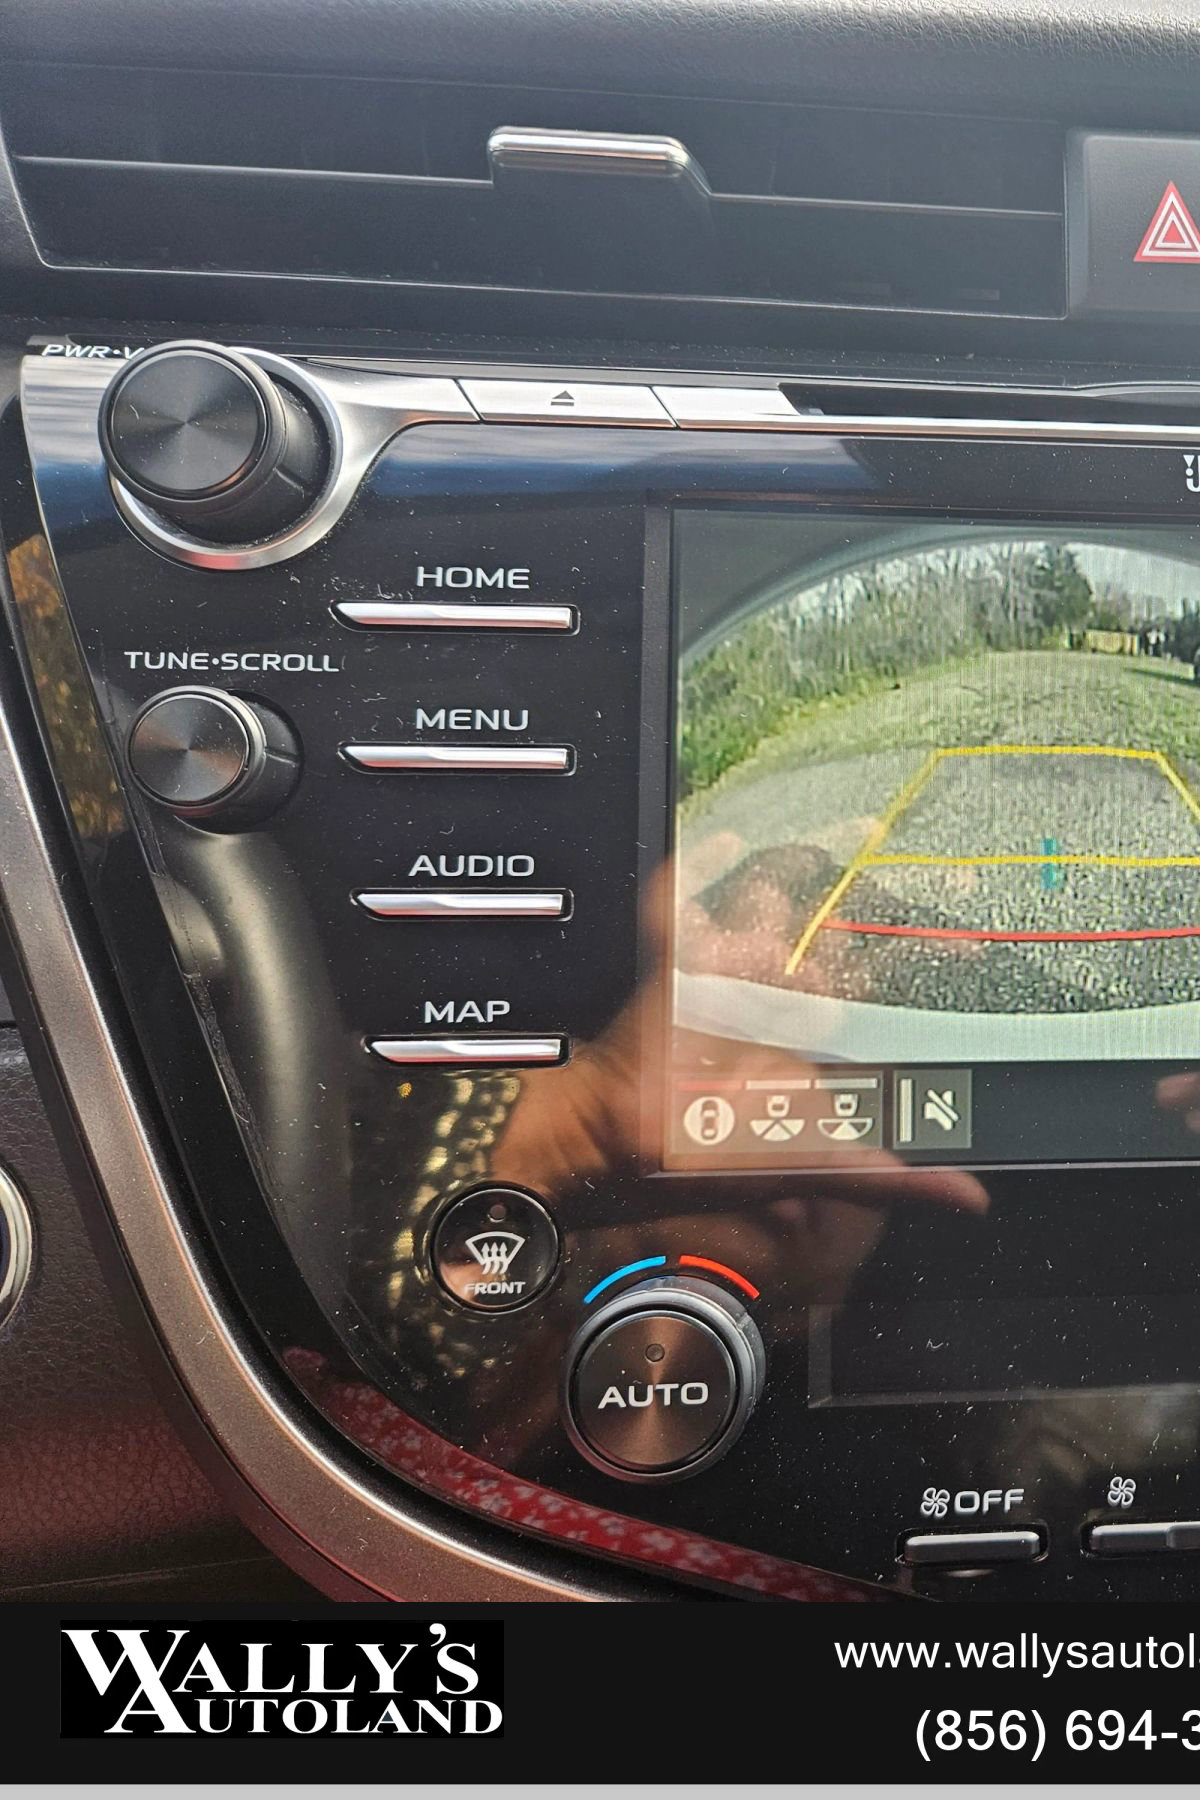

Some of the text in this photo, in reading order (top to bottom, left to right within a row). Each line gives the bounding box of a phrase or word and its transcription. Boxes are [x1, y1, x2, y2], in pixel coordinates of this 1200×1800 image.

[416, 566, 530, 589] HOME
[416, 708, 529, 731] MENU
[408, 854, 535, 877] AUDIO
[424, 1000, 510, 1024] MAP
[464, 1281, 526, 1295] FRONT
[597, 1382, 709, 1409] AUTO
[954, 1488, 1025, 1513] OFF
